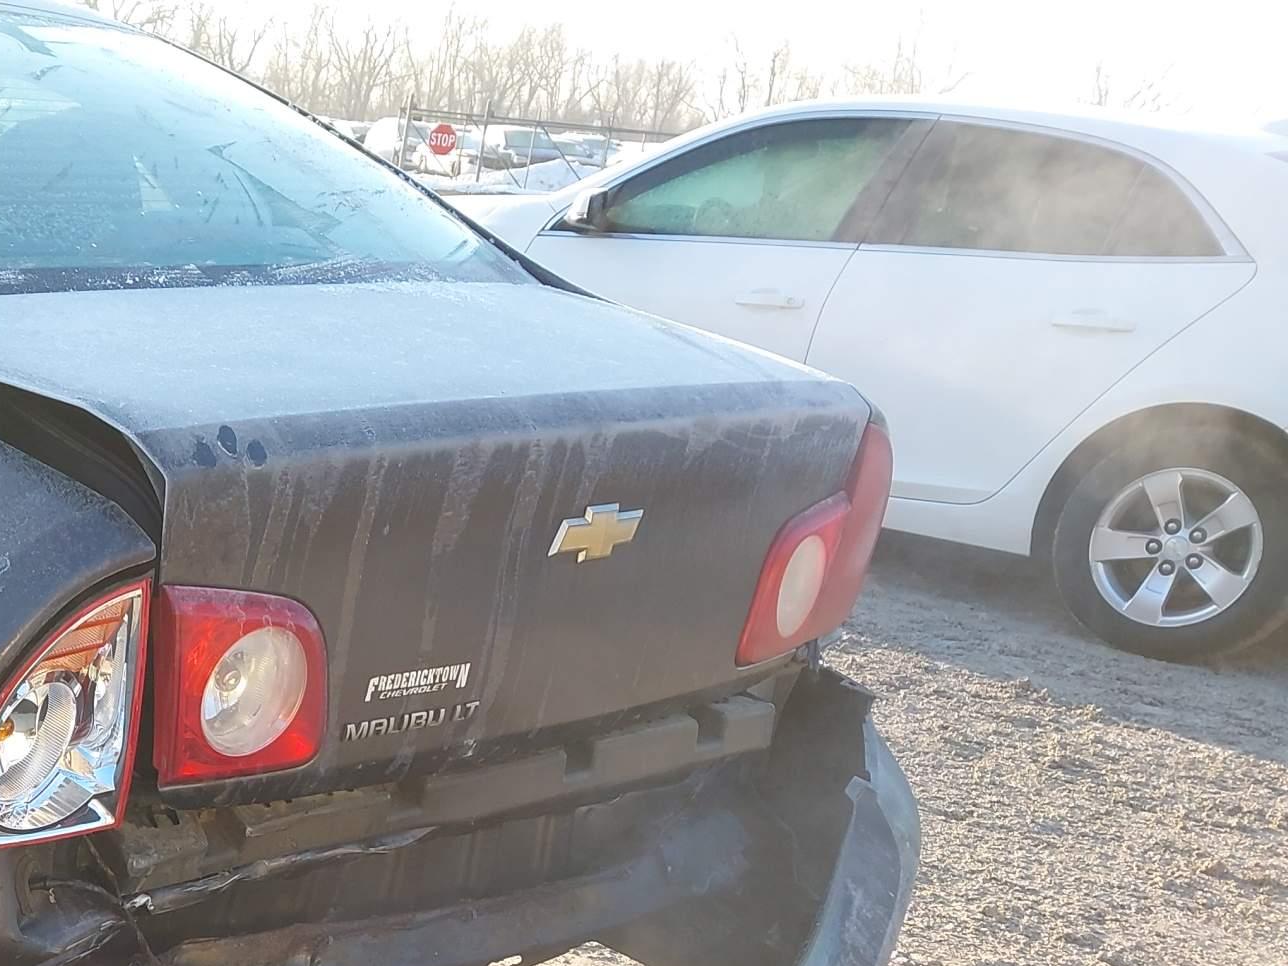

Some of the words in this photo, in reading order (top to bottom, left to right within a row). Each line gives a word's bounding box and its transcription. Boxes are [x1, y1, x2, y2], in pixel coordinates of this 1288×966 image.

[430, 132, 456, 147] STOP
[364, 662, 472, 703] FREDERICKTOWN
[379, 682, 448, 700] CHEVROLET
[344, 708, 447, 742] MALIBU
[454, 701, 481, 721] LT
